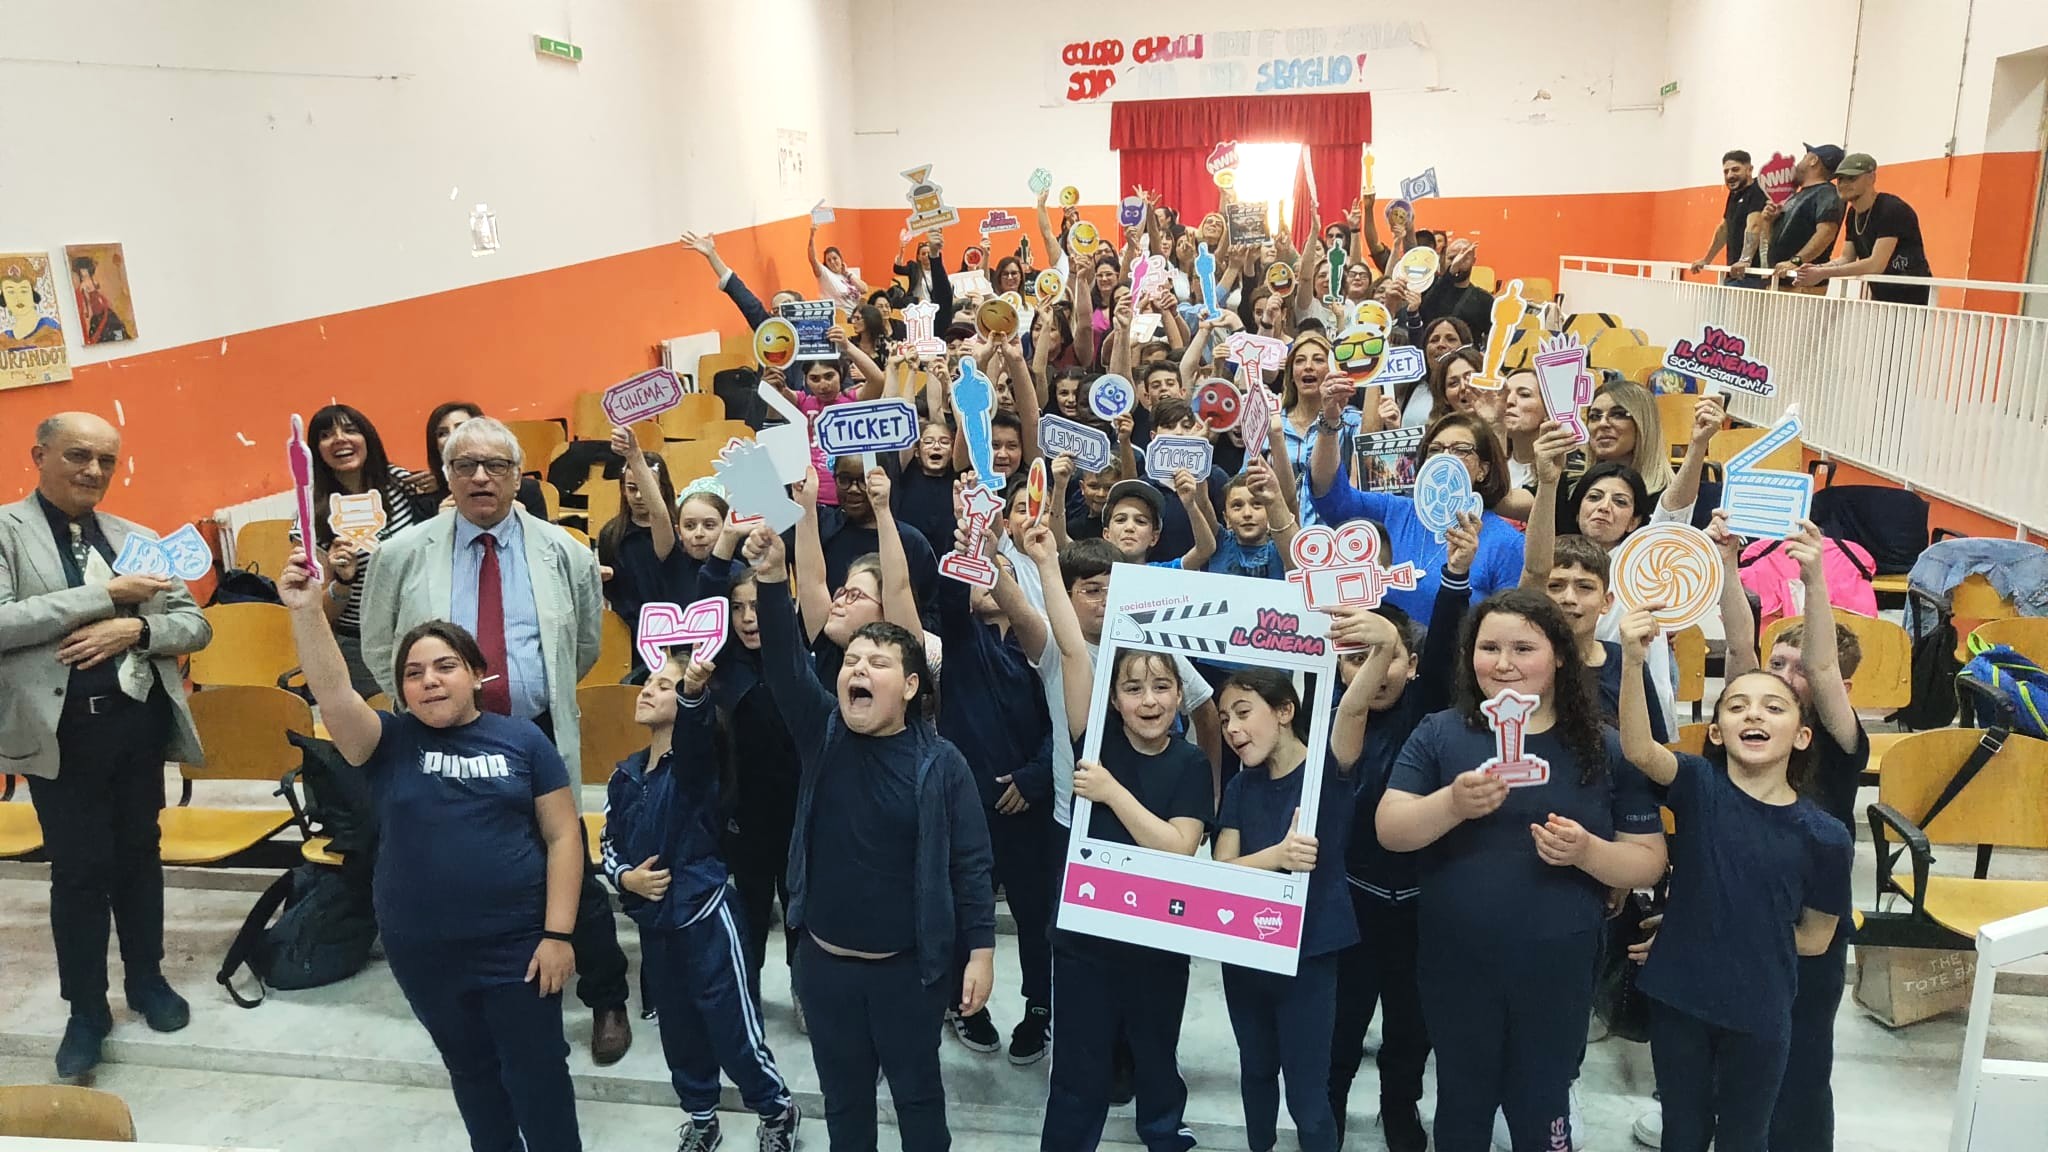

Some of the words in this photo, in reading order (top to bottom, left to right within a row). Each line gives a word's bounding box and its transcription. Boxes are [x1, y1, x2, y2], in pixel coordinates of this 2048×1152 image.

[1704, 326, 1745, 356] VIVA
[0, 348, 67, 370] URANDOT
[1386, 356, 1413, 374] KET
[1674, 339, 1694, 360] IL
[1694, 342, 1768, 384] CINEMA
[1668, 354, 1773, 396] SOCIALSTATION.IT
[834, 416, 902, 441] TICKET
[1048, 427, 1096, 461] TICKET
[1159, 447, 1203, 471] TICKET
[1119, 595, 1190, 612] socialstation.it
[1256, 608, 1299, 632] VIVA
[1229, 626, 1250, 646] IL
[1249, 629, 1326, 656] CINEMA
[422, 751, 510, 779] PUMA
[1903, 973, 1949, 992] TOTE
[1954, 963, 1975, 980] BA
